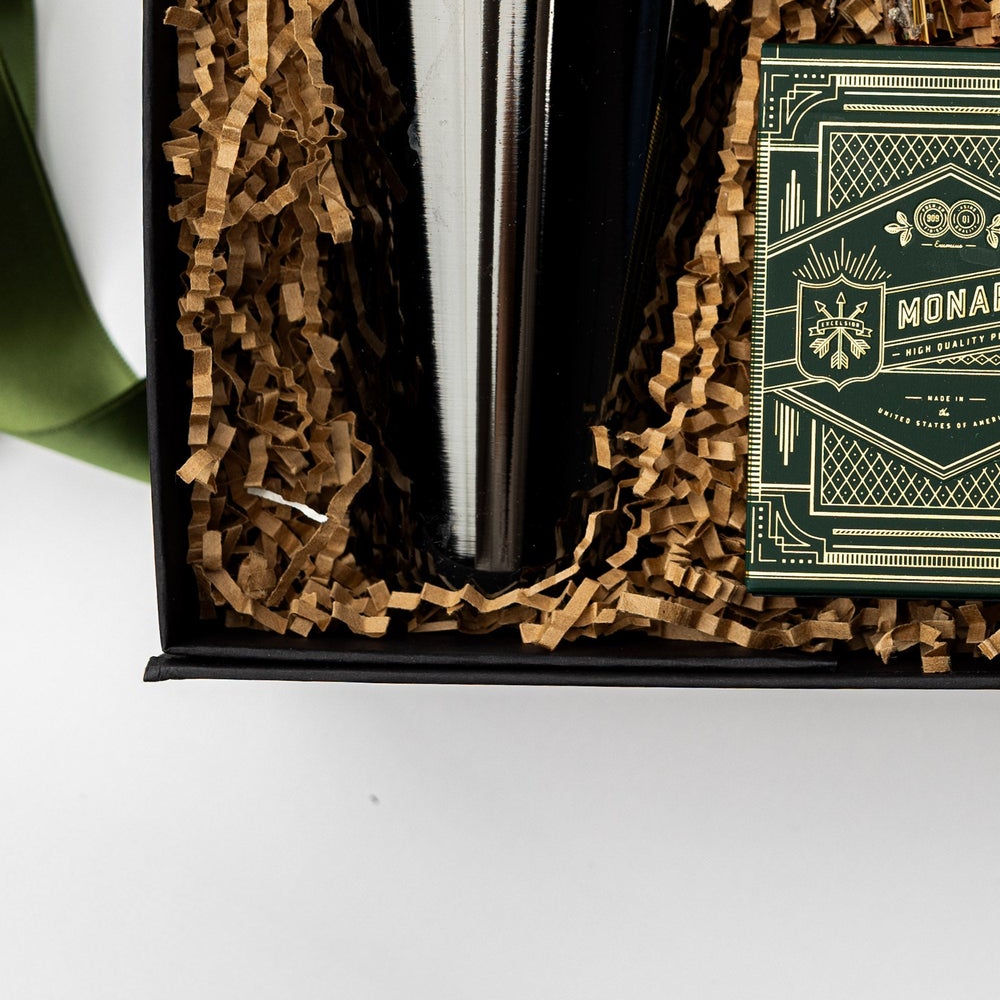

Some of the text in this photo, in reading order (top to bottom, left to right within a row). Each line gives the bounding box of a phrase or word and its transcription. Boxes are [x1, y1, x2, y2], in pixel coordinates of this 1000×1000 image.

[905, 345, 932, 357] HIGH
[937, 335, 985, 353] QUALITY
[877, 407, 911, 424] UNITED
[915, 420, 952, 429] STATES
